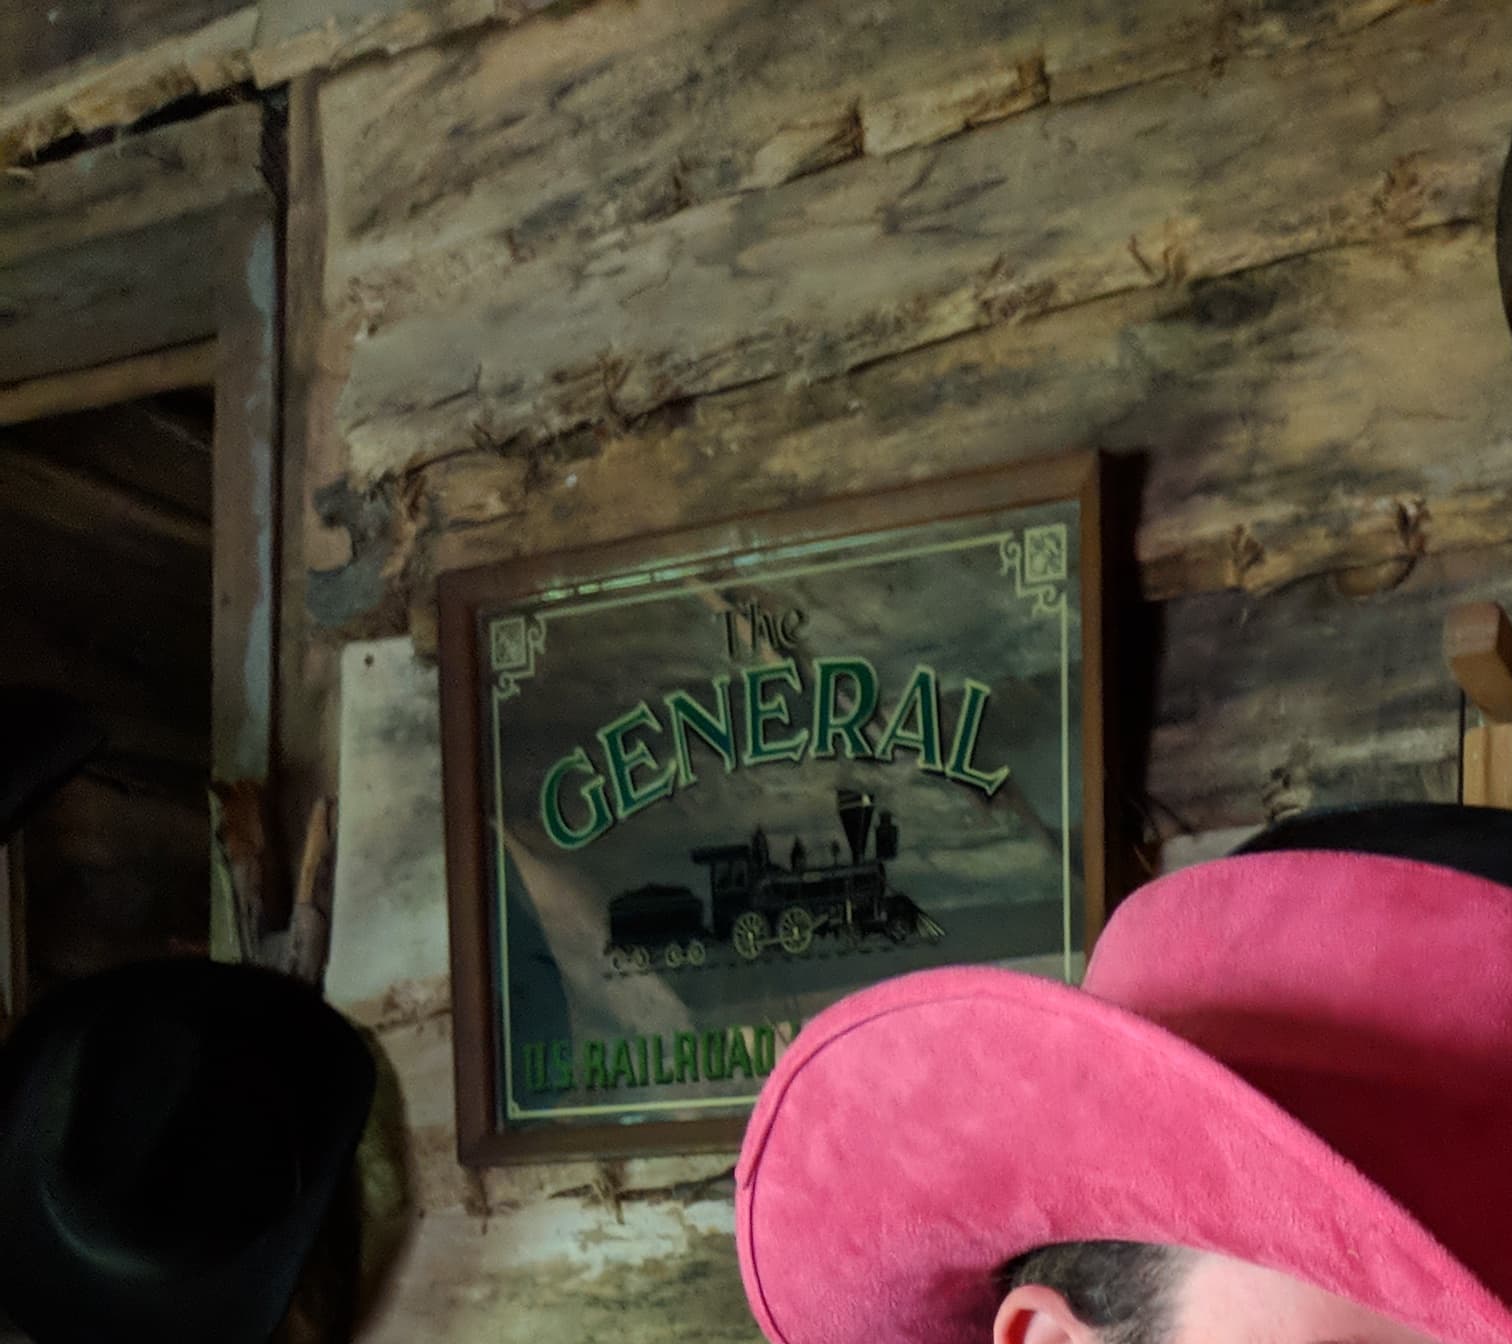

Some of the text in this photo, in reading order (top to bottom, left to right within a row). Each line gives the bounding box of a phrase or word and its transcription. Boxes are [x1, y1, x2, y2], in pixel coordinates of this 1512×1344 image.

[716, 598, 806, 660] The
[539, 655, 1011, 851] GENERAL
[582, 1024, 776, 1090] RAILROAD
